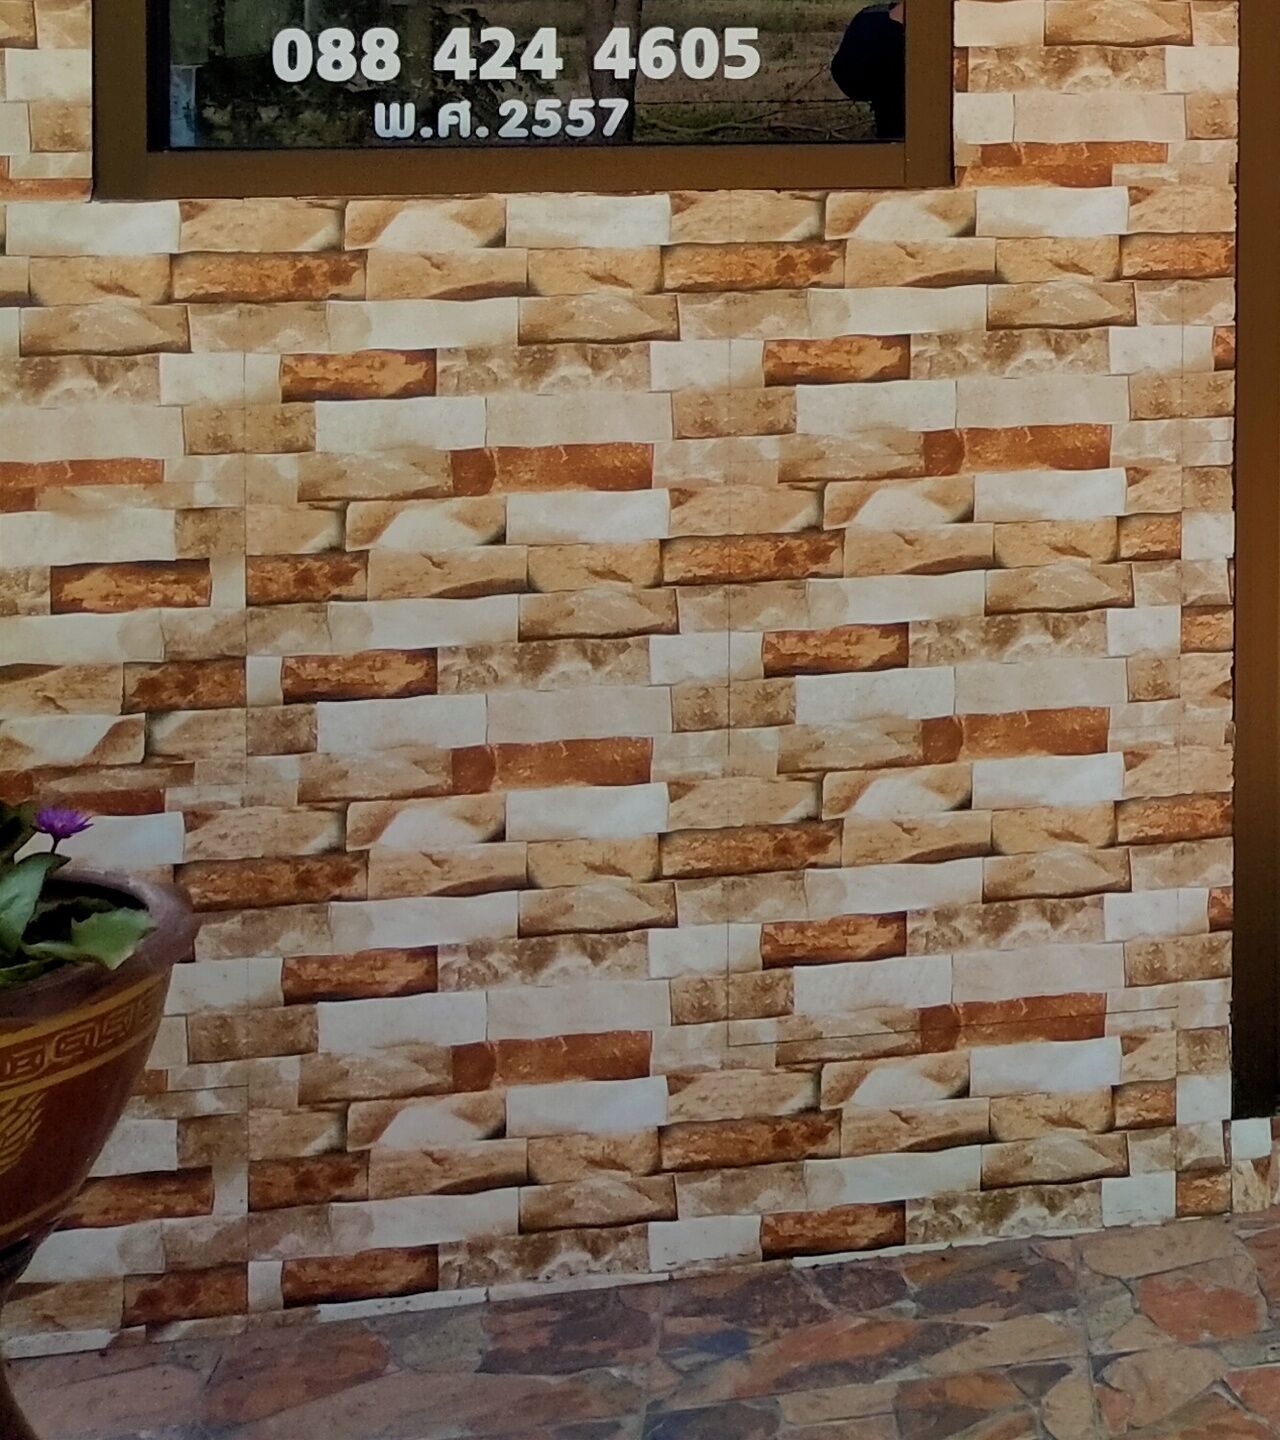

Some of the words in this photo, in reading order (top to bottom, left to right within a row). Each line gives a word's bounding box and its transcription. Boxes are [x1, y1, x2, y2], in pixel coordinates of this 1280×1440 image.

[272, 27, 402, 83] 088
[433, 26, 564, 81] 424
[593, 26, 761, 81] 4605
